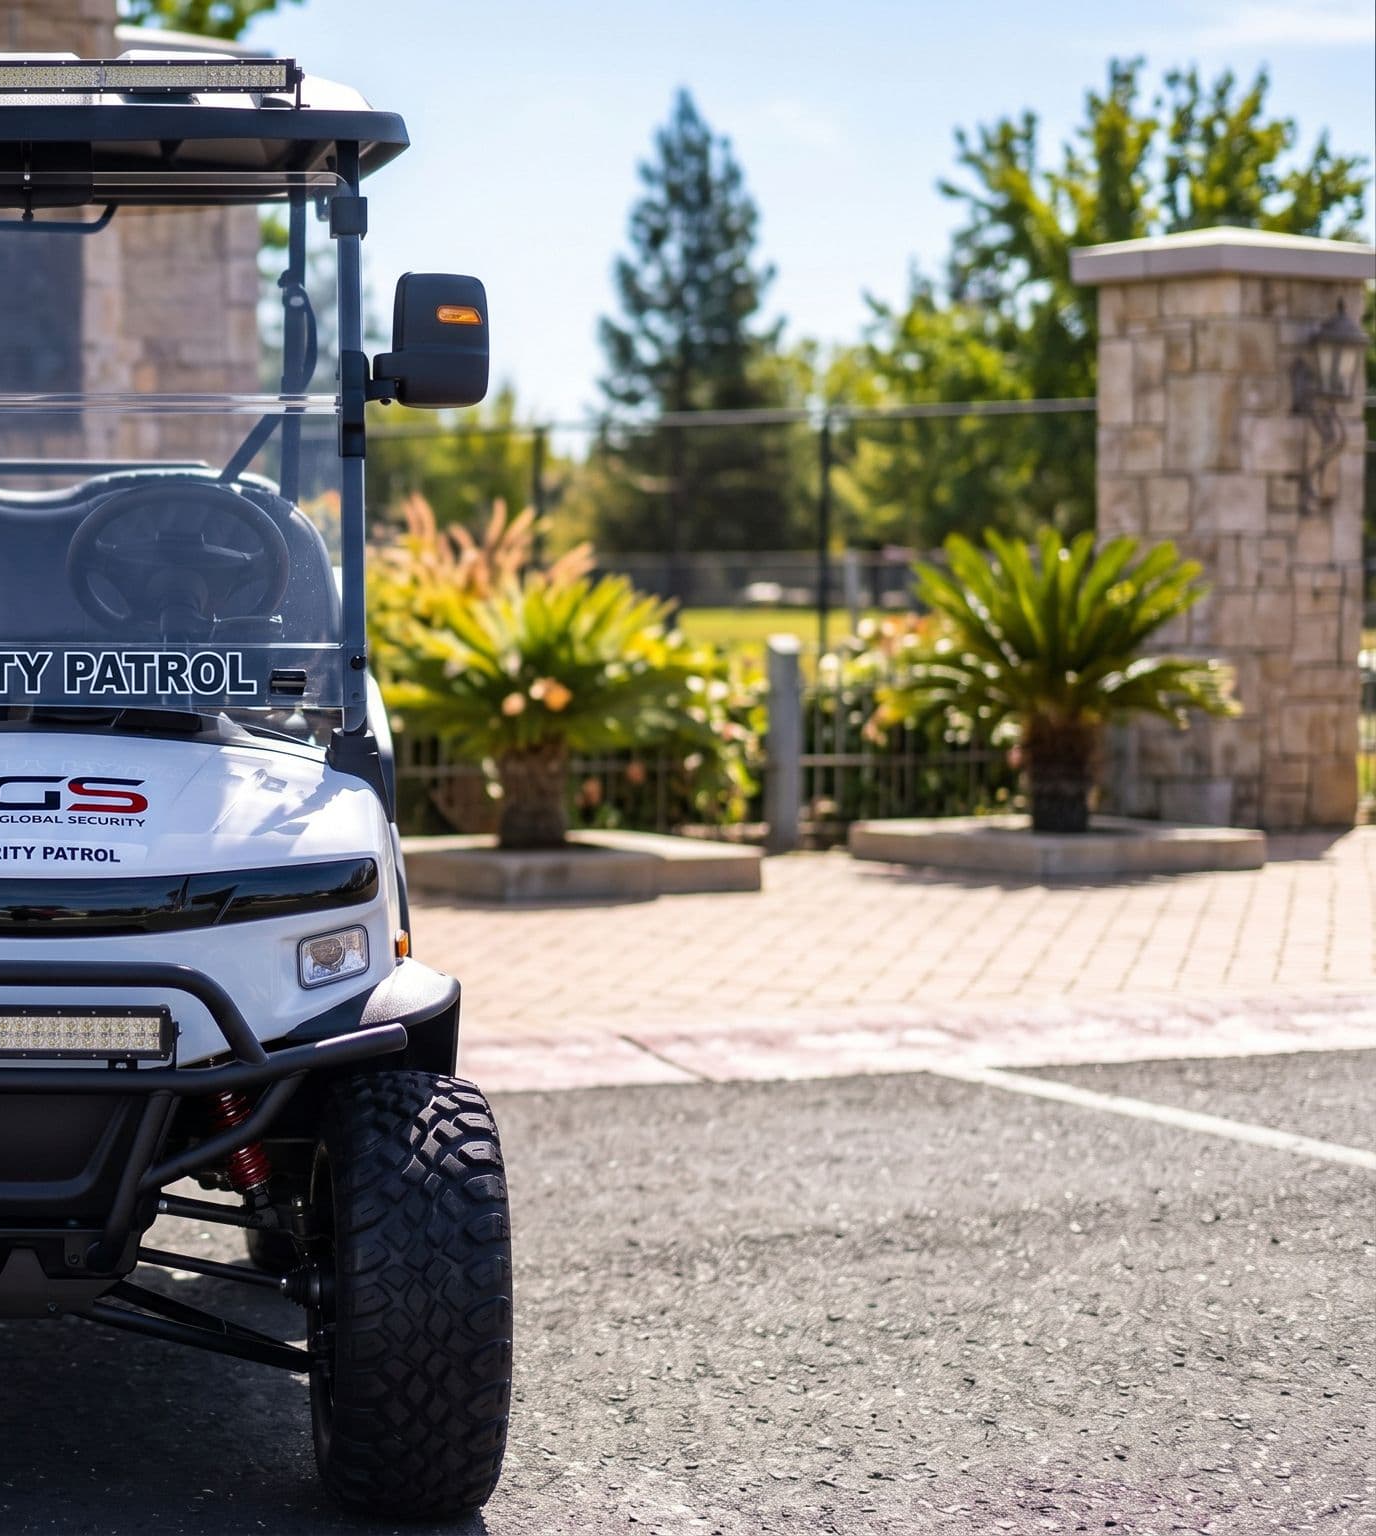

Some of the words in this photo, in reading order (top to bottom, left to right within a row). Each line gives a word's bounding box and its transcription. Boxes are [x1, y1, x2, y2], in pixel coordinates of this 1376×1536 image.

[63, 651, 258, 695] PATROL
[67, 815, 146, 828] SECURITY
[42, 846, 121, 863] PATROL
